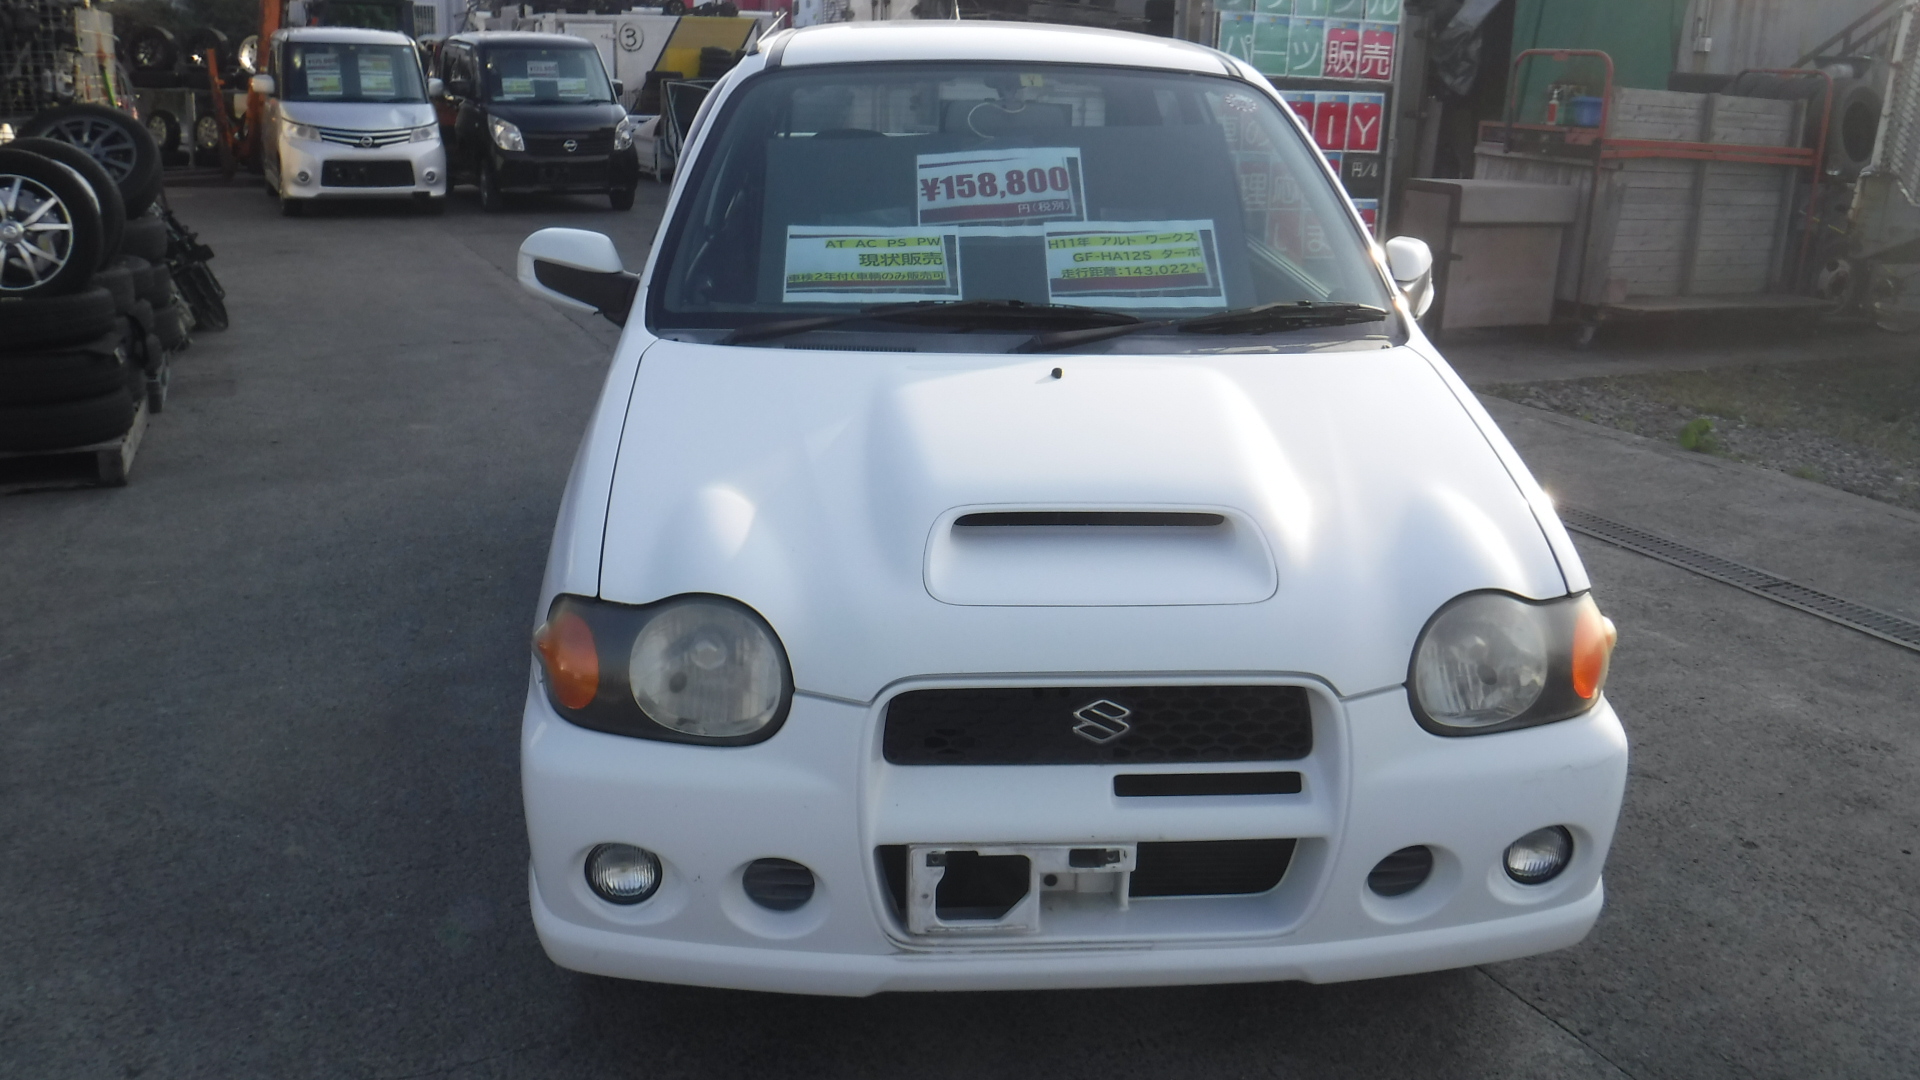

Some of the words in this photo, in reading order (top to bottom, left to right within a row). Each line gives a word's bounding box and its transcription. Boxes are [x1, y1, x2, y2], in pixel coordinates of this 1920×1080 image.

[1223, 34, 1391, 76] パーツ販売
[920, 166, 1069, 202] ¥158,800
[825, 240, 846, 249] AT
[855, 239, 877, 248] AC
[887, 238, 906, 247] PS
[917, 237, 941, 246] PW
[1048, 237, 1091, 249] H11年
[1101, 236, 1136, 246] アルト
[1145, 232, 1197, 245] ワークス
[859, 252, 942, 266] 現状販売
[1073, 250, 1152, 262] GF-HA12S
